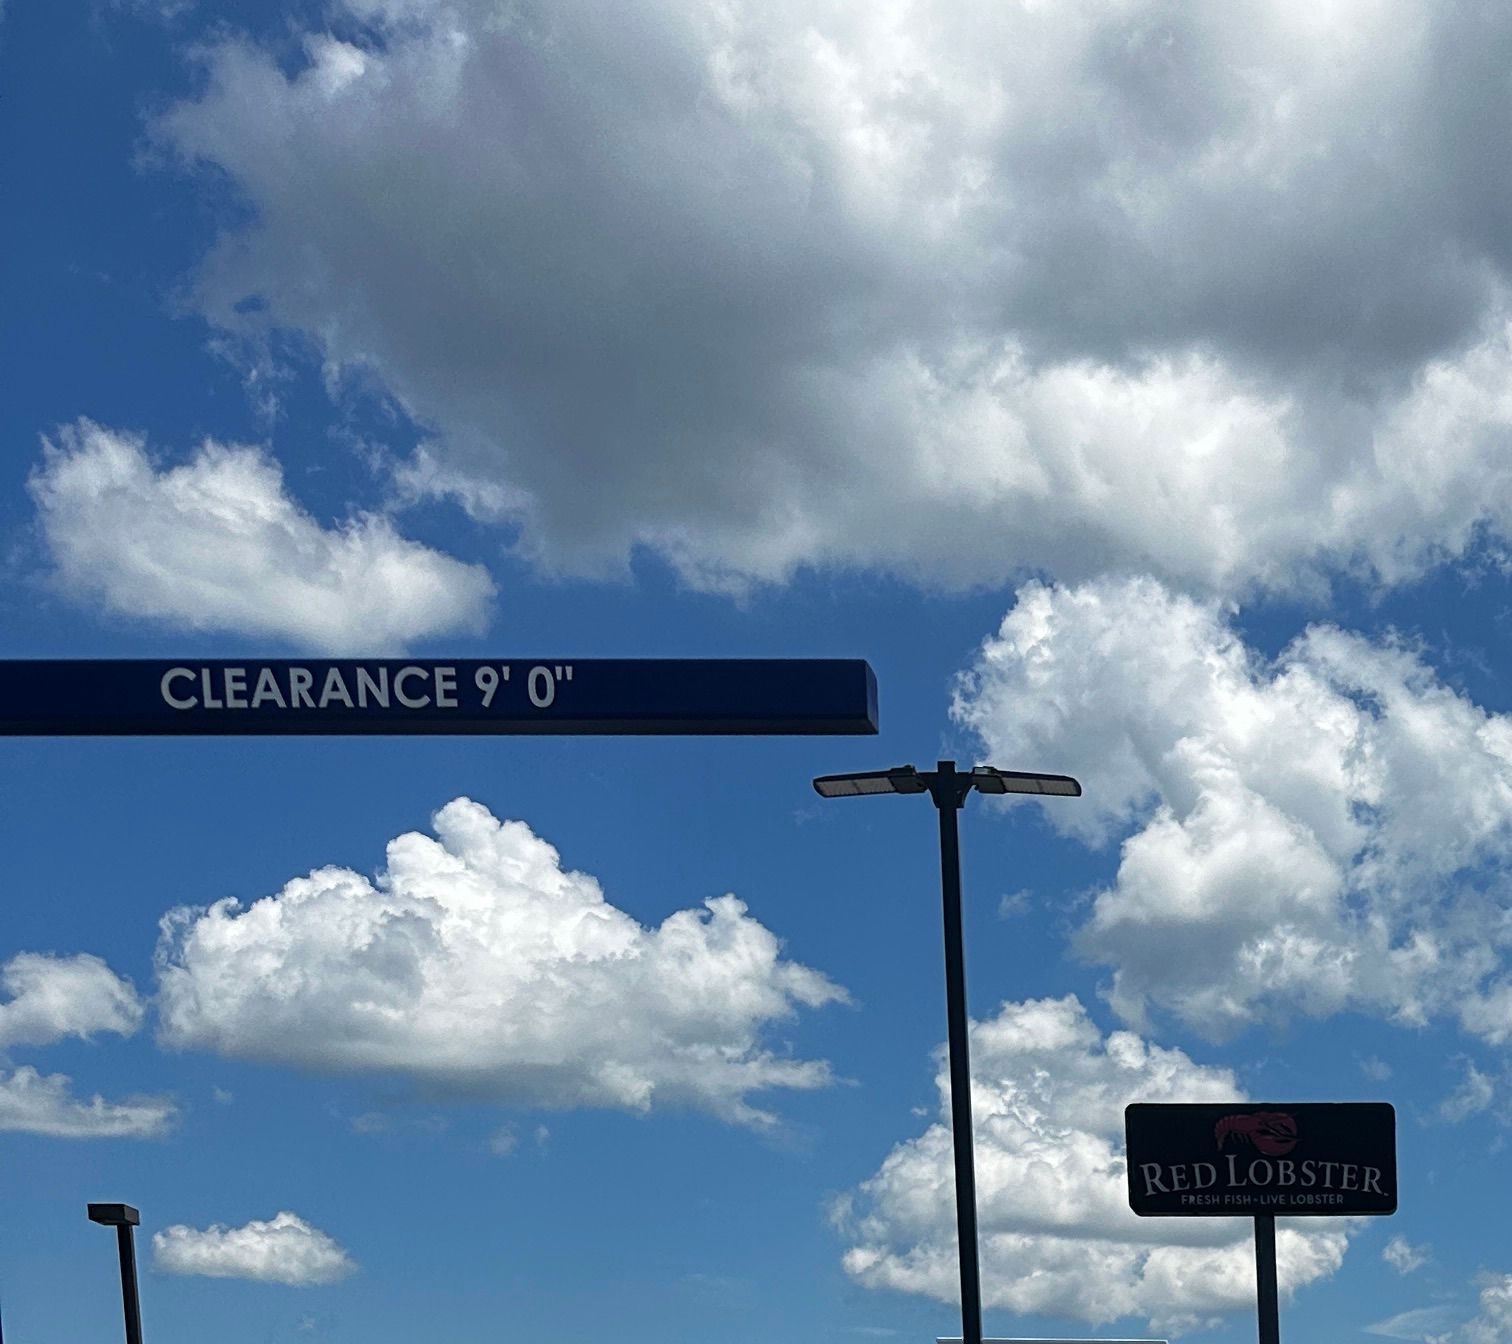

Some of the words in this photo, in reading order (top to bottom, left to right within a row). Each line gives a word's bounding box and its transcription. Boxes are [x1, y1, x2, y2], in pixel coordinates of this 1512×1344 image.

[159, 666, 459, 710] CLEARANCE
[474, 665, 511, 709] 9'
[526, 665, 574, 709] 0"
[1140, 1161, 1217, 1196] RED
[1224, 1154, 1386, 1197] LOBSTER
[1181, 1194, 1220, 1205] FRESH
[1290, 1194, 1344, 1206] LOBSTER
